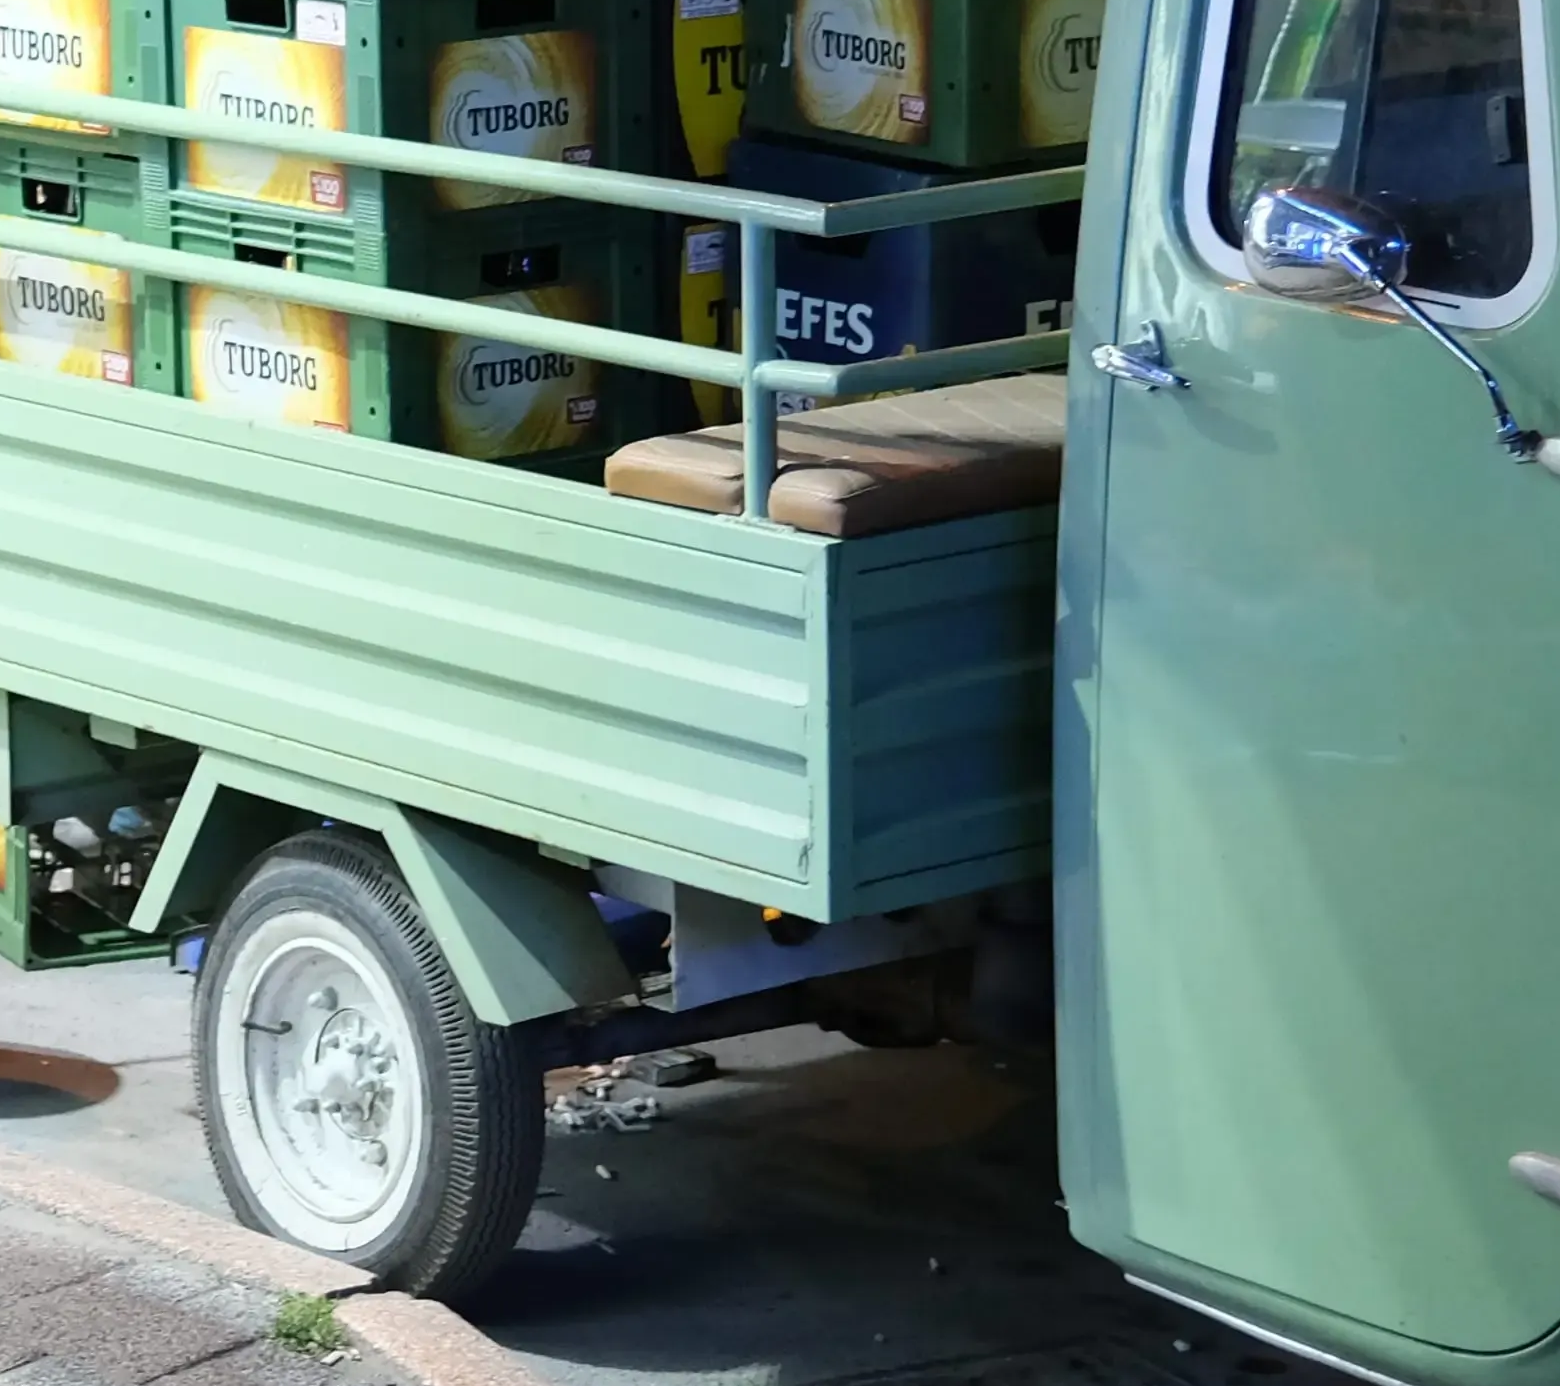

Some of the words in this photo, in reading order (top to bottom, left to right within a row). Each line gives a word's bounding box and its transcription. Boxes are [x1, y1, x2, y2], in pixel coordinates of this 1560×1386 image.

[822, 28, 907, 71] TUBORG
[467, 97, 571, 138] TUBORG
[16, 275, 106, 322] TUBORG
[777, 288, 874, 355] EFES
[222, 341, 318, 391] TUBORG
[473, 353, 575, 391] TUBORG
